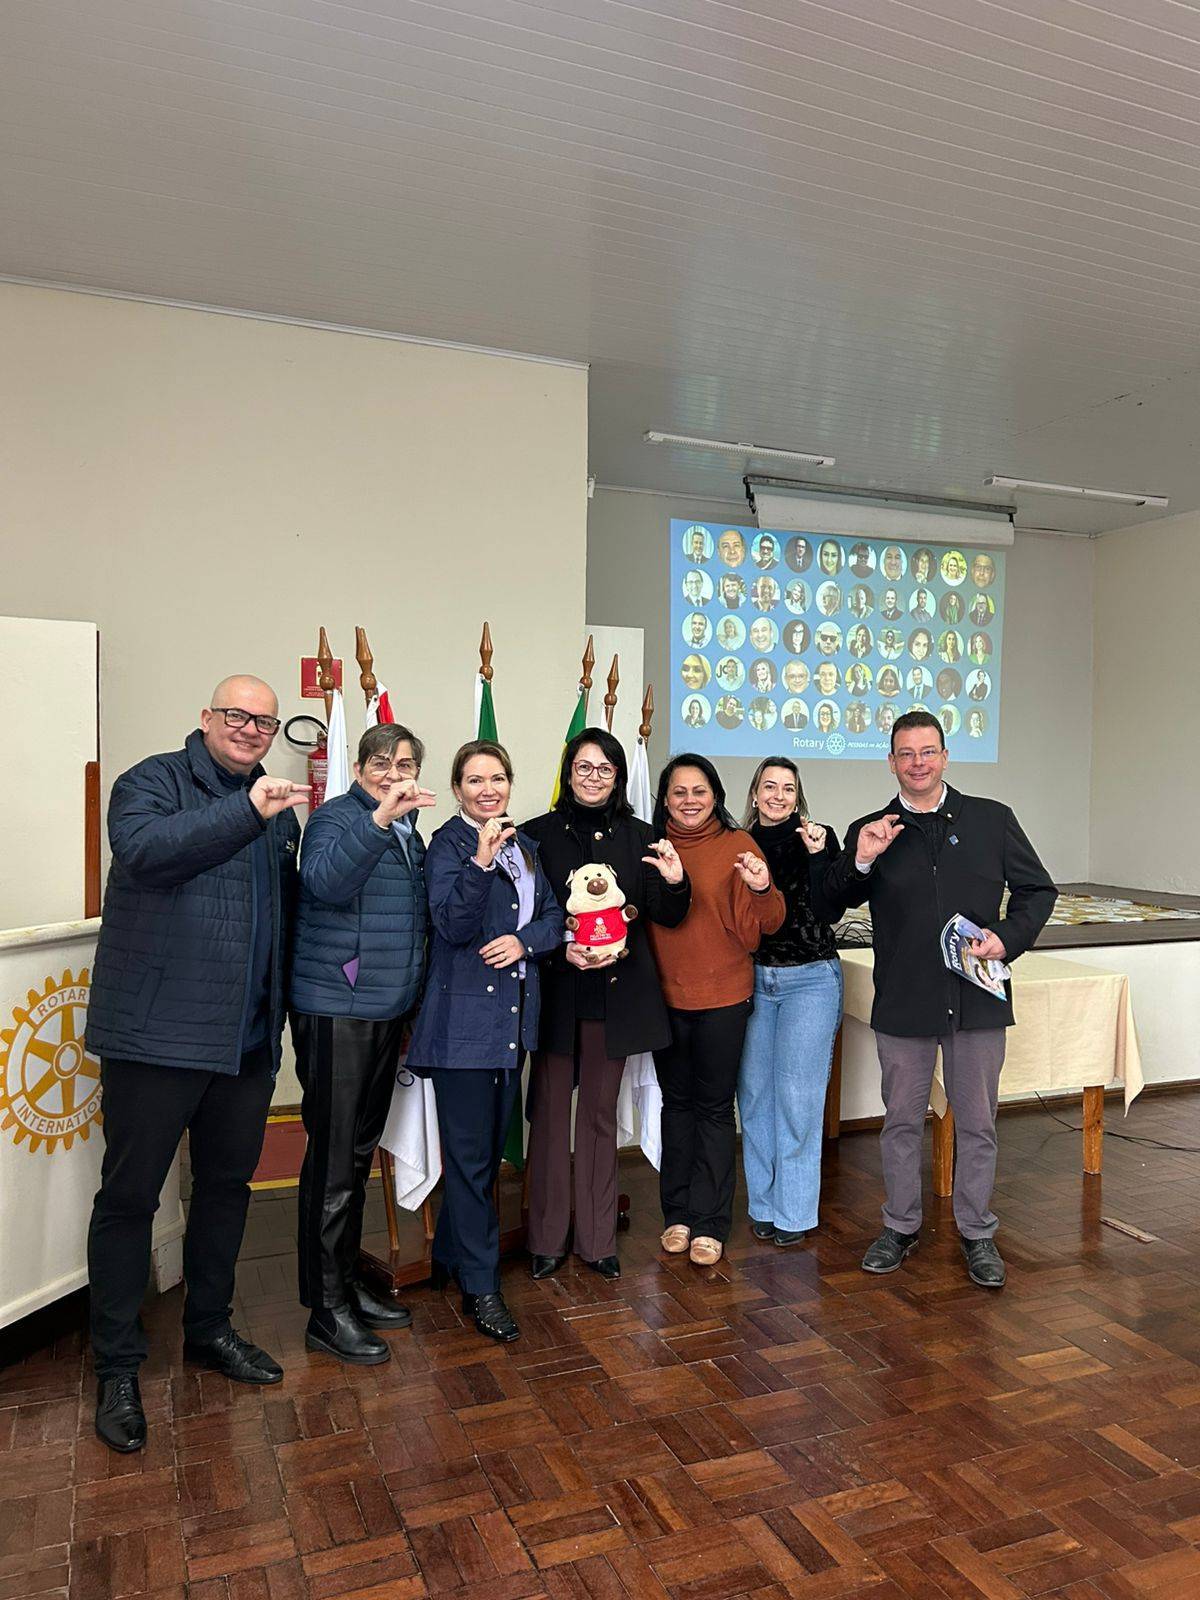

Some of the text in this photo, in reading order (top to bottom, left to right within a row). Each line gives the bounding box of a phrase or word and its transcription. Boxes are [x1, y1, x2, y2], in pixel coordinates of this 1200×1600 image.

[793, 737, 825, 750] Rotary
[37, 988, 86, 1017] ROTAR
[17, 1086, 103, 1134] INTERNATION
